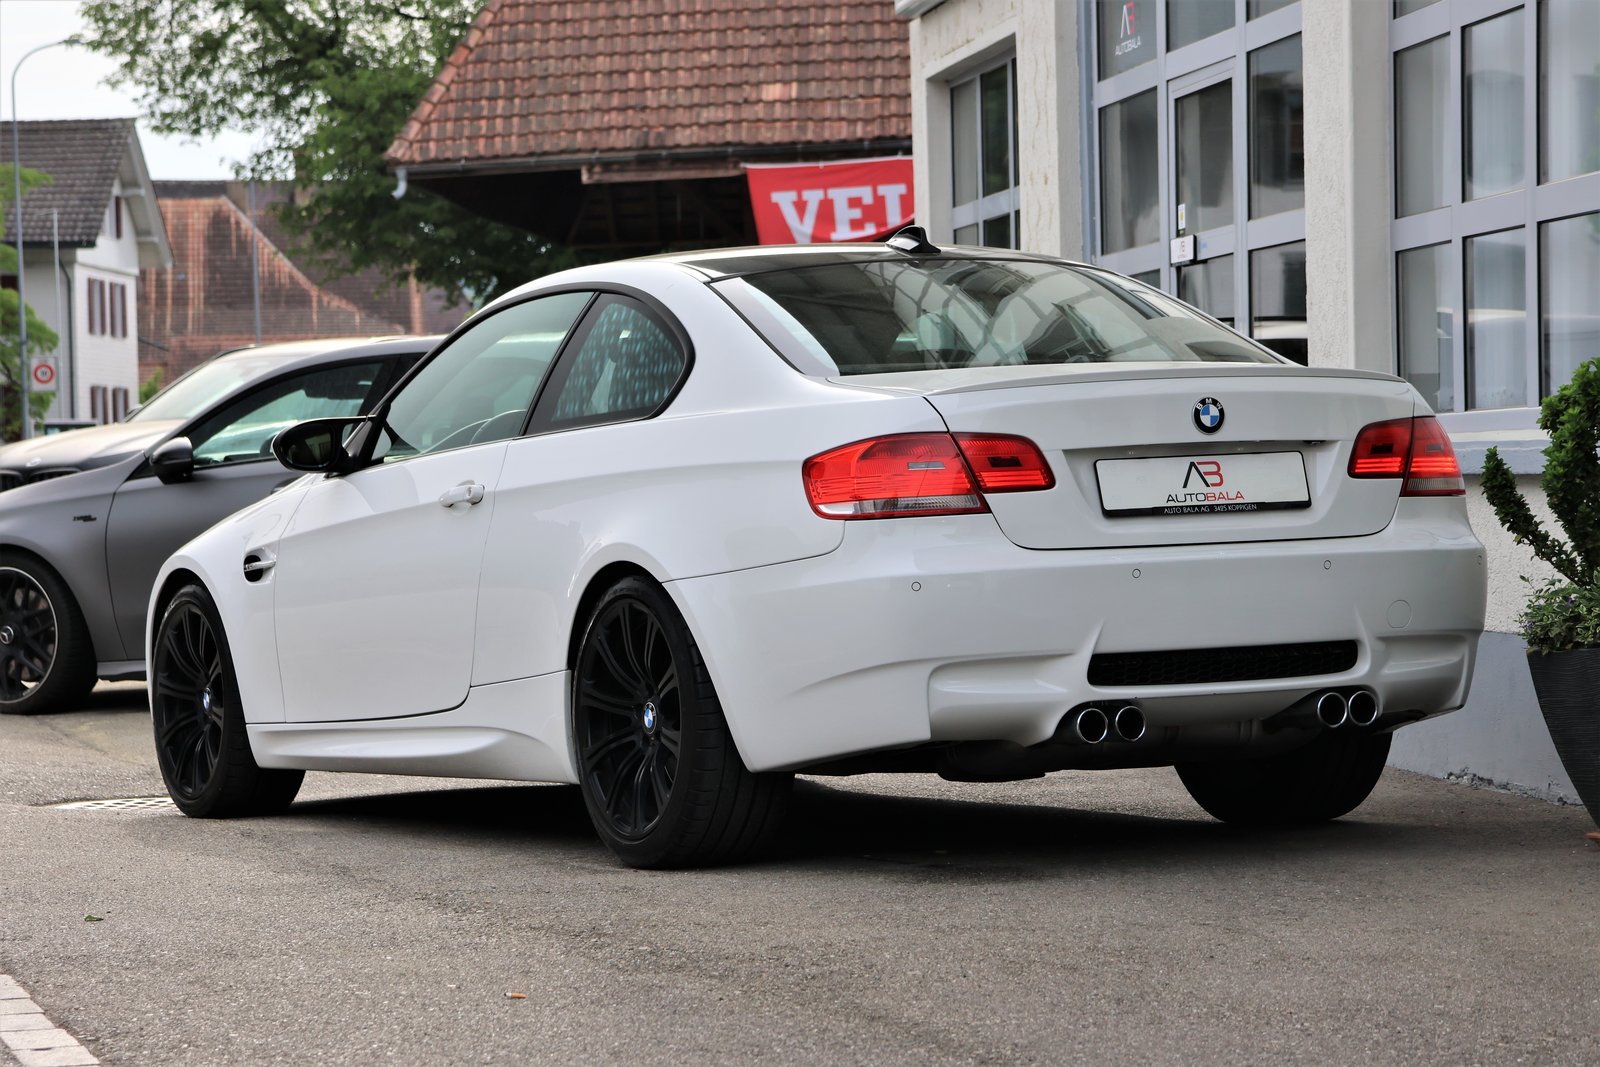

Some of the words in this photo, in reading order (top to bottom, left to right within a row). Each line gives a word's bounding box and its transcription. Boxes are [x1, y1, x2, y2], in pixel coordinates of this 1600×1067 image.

[1182, 461, 1224, 489] AB
[1166, 491, 1245, 503] AUTOBALA
[1228, 503, 1257, 511] KOPPIGEN
